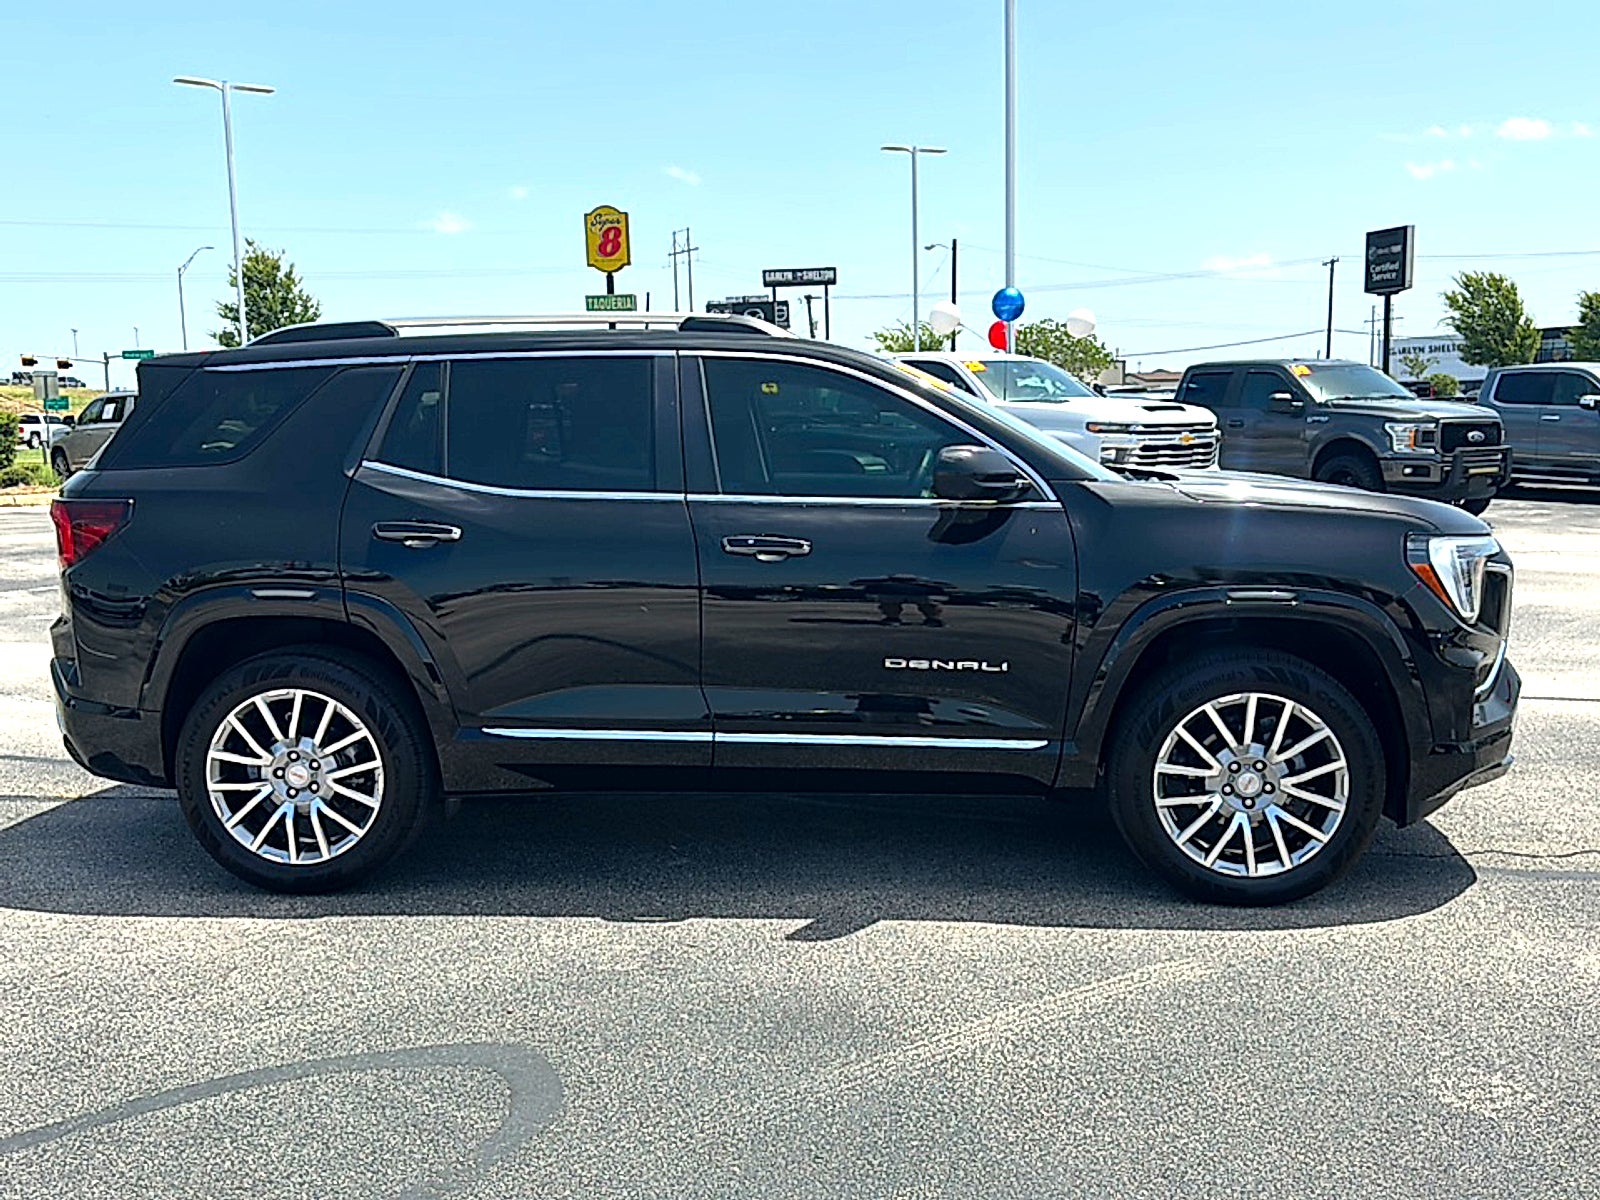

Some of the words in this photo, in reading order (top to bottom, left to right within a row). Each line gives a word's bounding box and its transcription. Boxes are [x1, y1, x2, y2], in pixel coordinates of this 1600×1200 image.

[590, 213, 621, 232] Super
[598, 226, 622, 257] 8
[1370, 261, 1400, 273] Certified
[1371, 271, 1397, 281] Service
[884, 658, 1009, 672] DENALI
